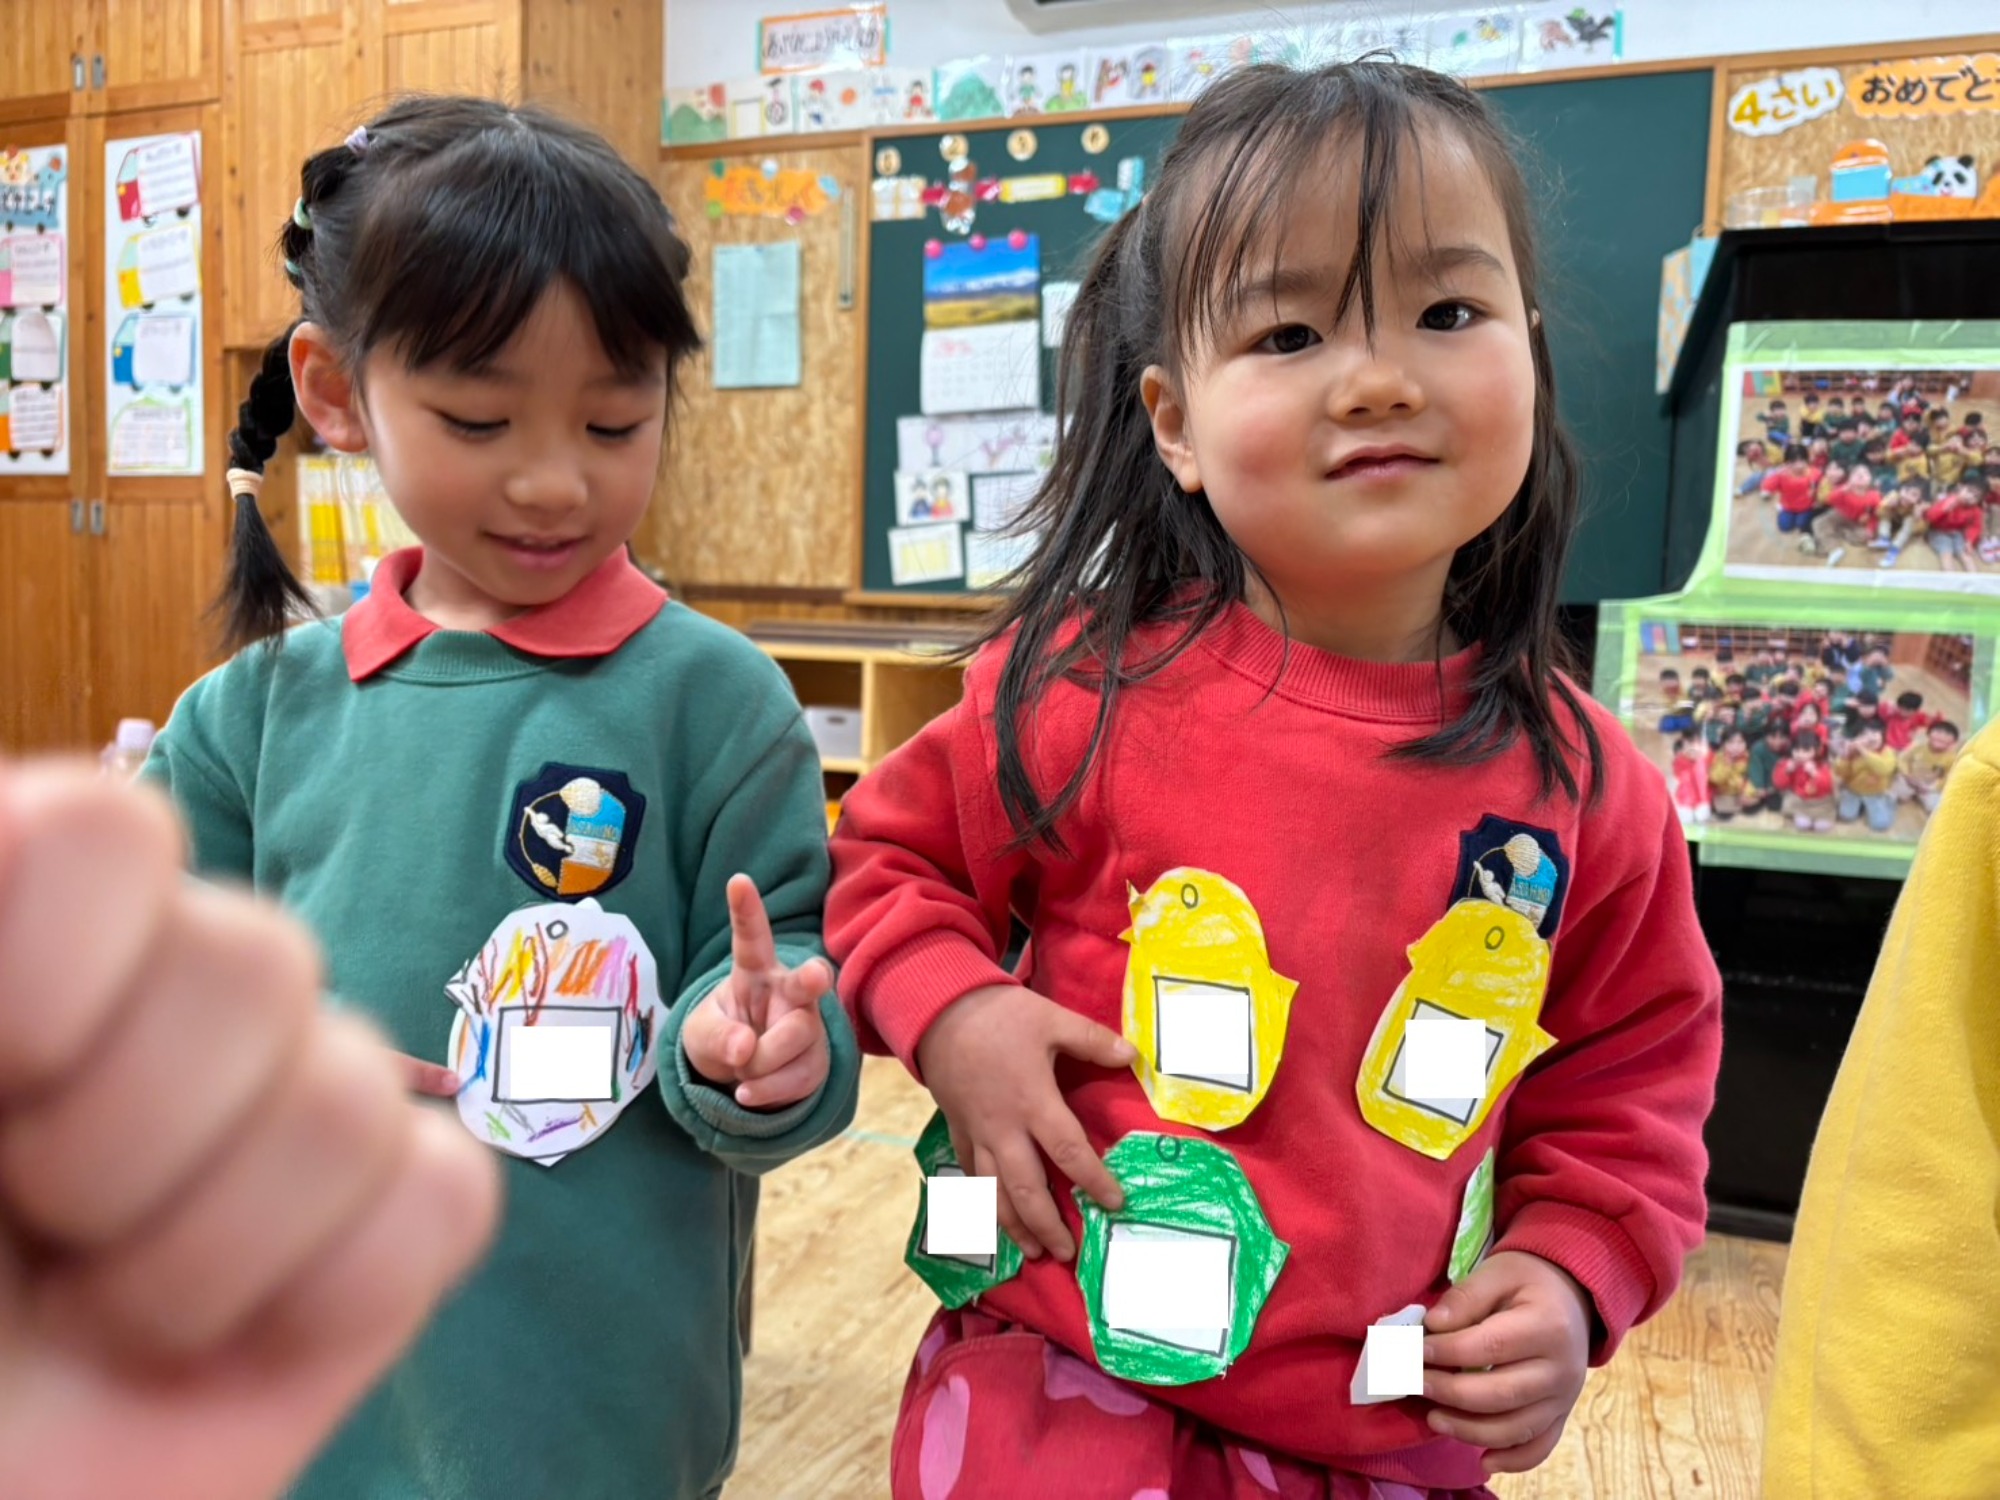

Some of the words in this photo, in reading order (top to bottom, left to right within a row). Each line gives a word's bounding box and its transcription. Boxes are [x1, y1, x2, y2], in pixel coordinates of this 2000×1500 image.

[1734, 78, 1836, 128] 4さい
[1861, 65, 2000, 105] おめでと
